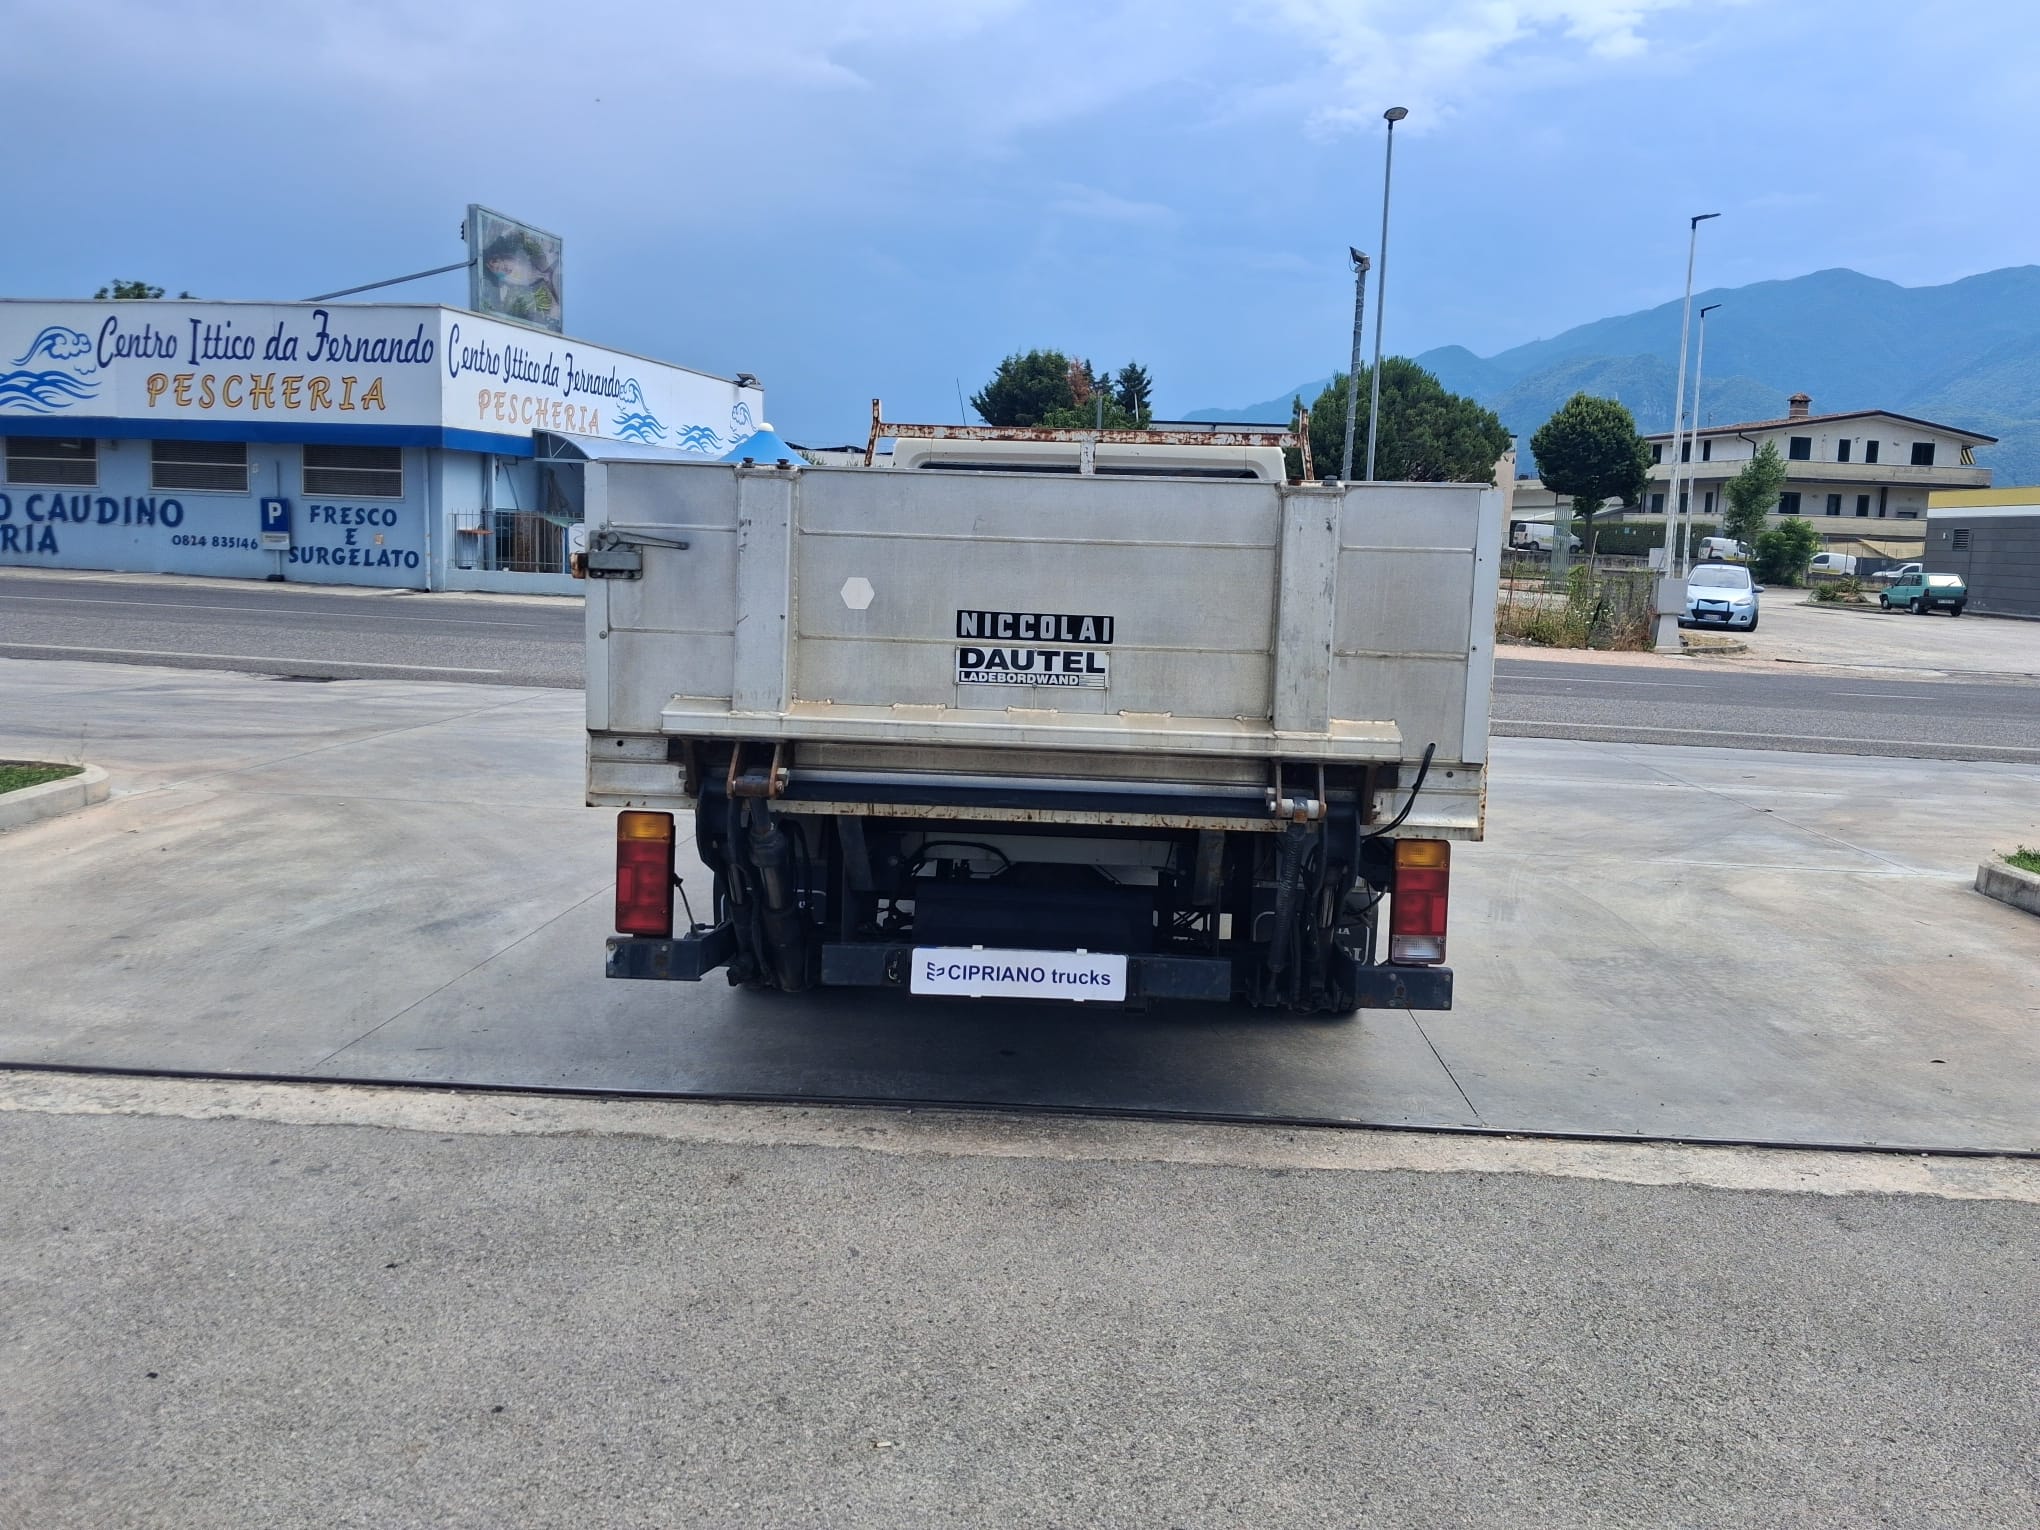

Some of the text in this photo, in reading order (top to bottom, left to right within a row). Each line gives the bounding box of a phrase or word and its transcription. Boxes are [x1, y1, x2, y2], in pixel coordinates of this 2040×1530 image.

[97, 309, 434, 369] Centro Ittico da Fernando
[448, 323, 621, 399] Centro Ittico da Fernando
[147, 372, 387, 411] PESCHERIA
[478, 389, 600, 435] PESCHERIA
[26, 493, 185, 528] CAUDINO
[268, 501, 282, 524] P
[310, 504, 398, 527] FRESCO
[172, 534, 207, 547] 0824
[211, 536, 258, 552] 835146
[345, 528, 357, 545] E
[288, 547, 420, 569] SURGELATO
[960, 612, 1110, 642] NICCOLAI
[959, 647, 1105, 673] DAUTEL
[960, 671, 1079, 686] LADEBORDWAND
[948, 964, 1111, 986] CIPRIANO trucks
